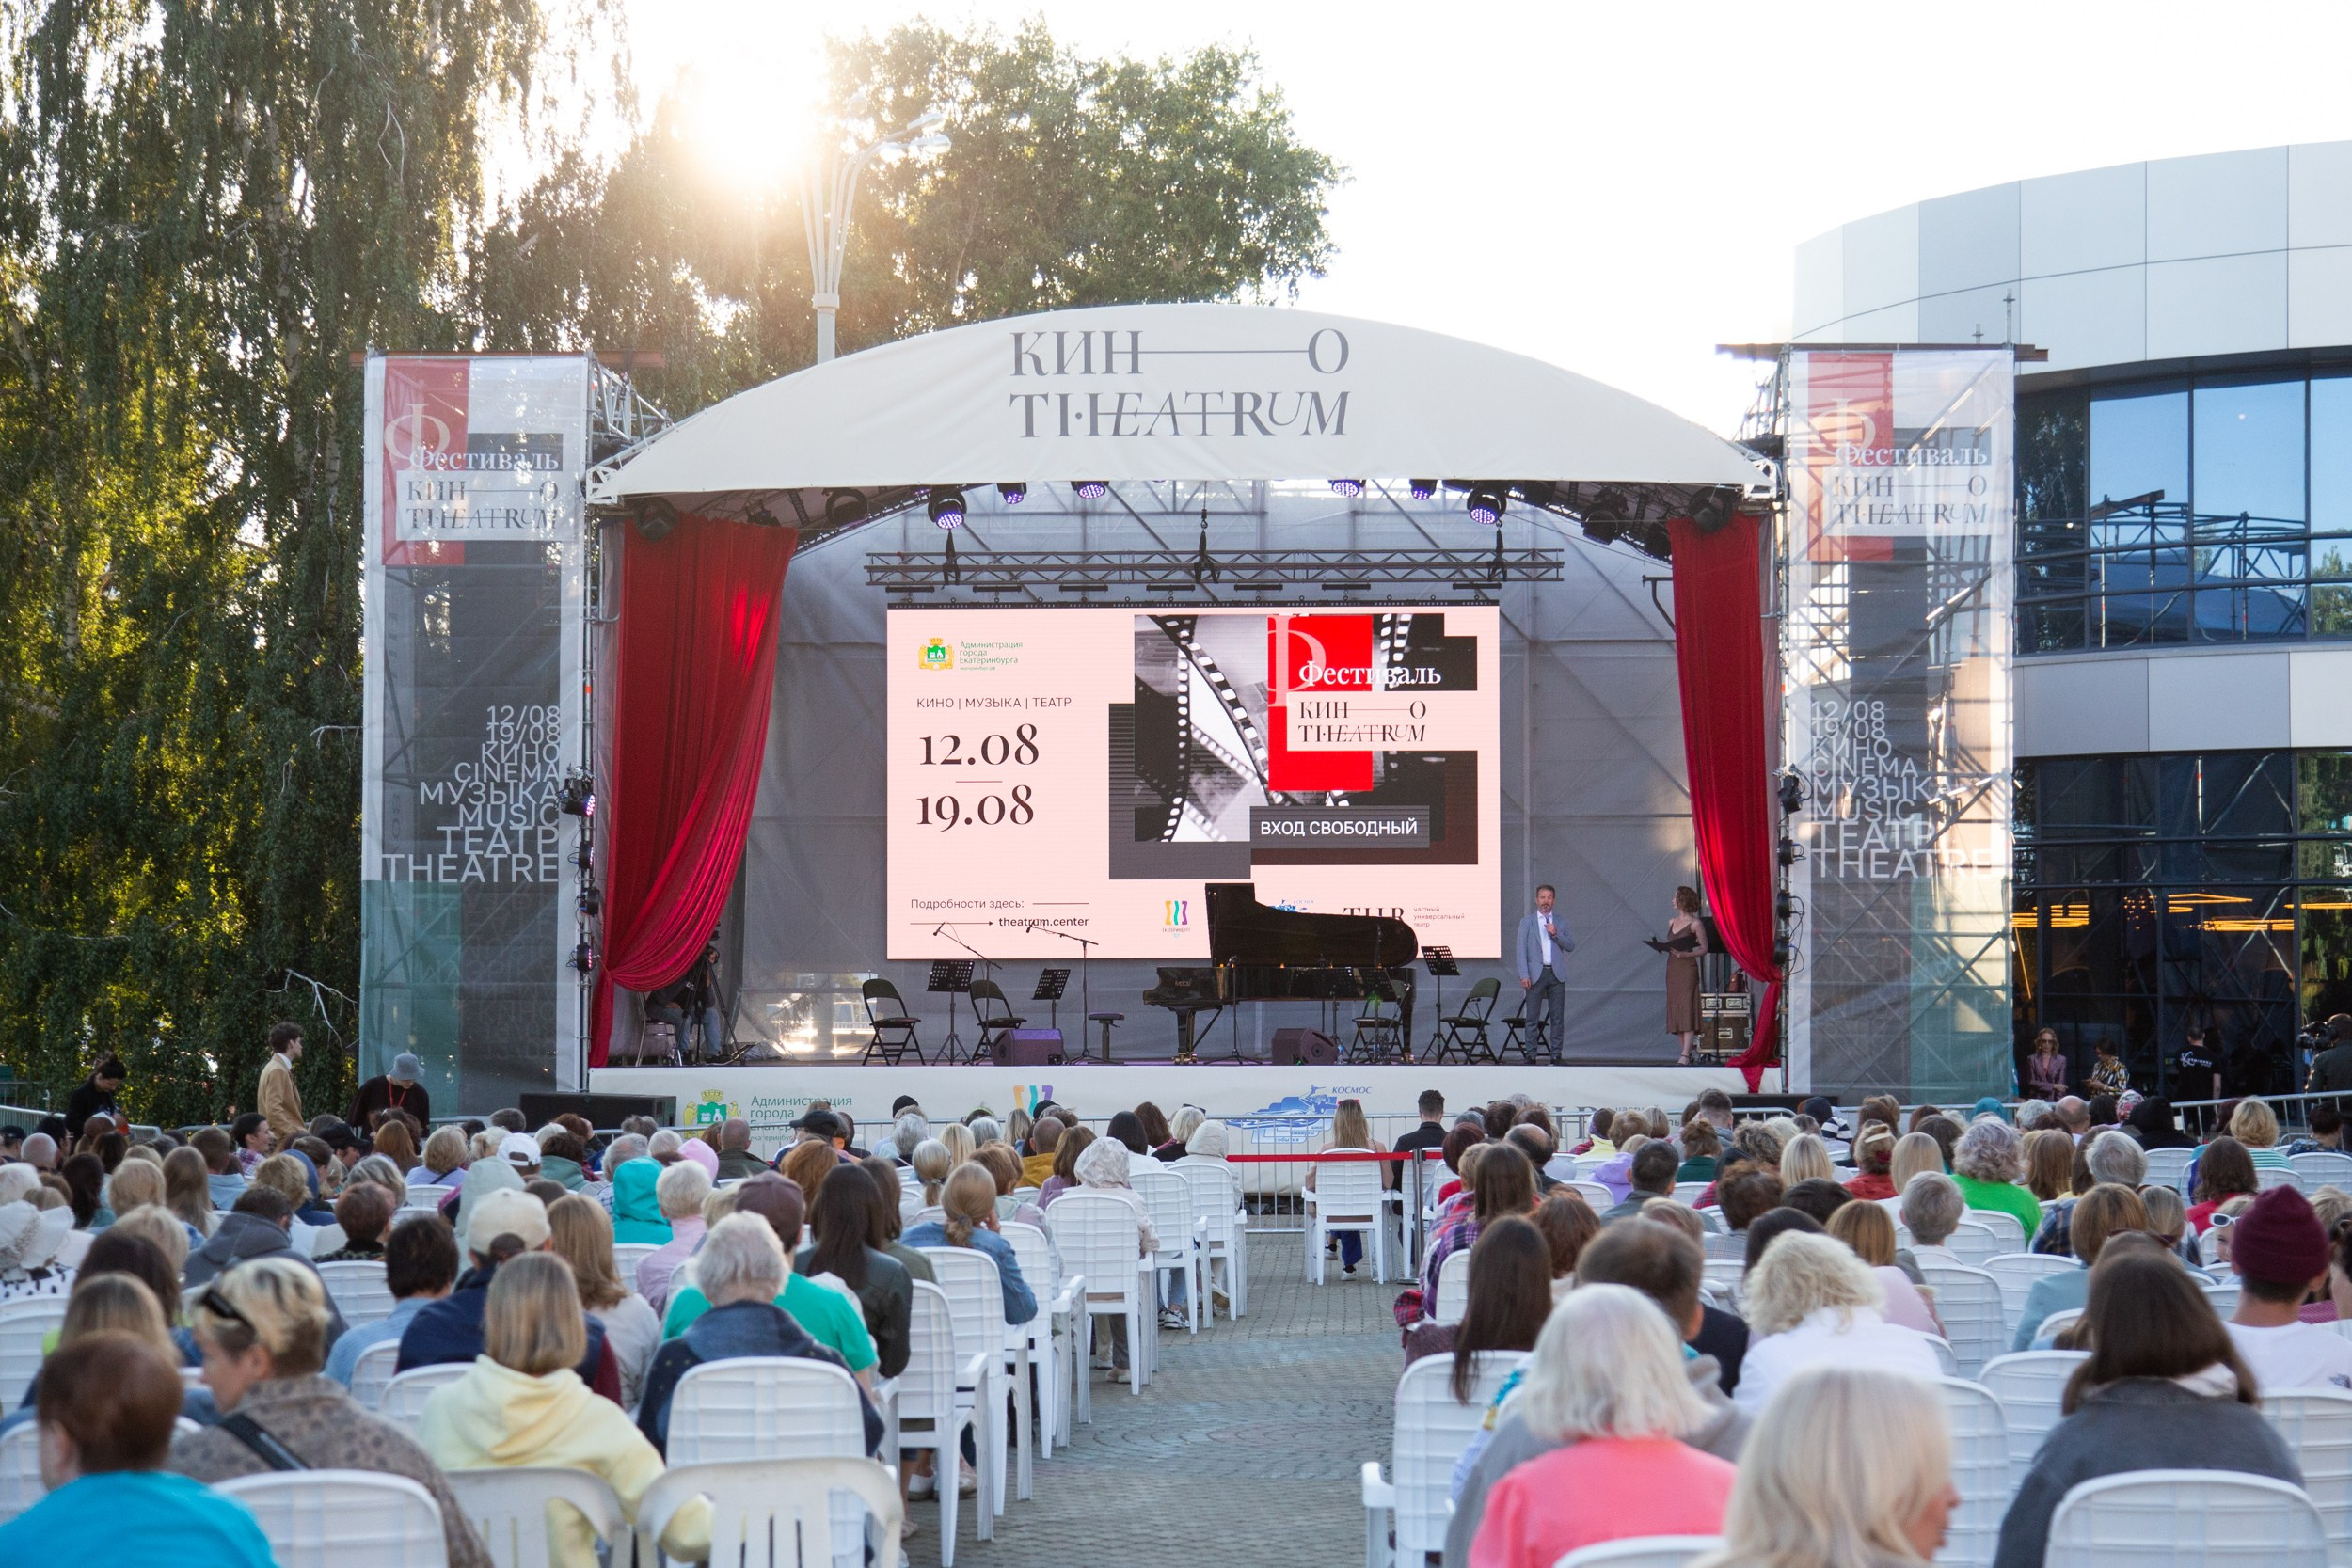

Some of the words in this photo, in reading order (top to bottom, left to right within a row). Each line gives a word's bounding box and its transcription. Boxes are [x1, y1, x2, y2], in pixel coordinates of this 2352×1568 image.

[409, 447, 559, 472] Фестиваль
[1836, 441, 1987, 467] Фестиваль
[960, 657, 1019, 665] Екатеринбурга
[1298, 660, 1441, 687] Фестиваль
[916, 698, 954, 708] КИНО
[965, 698, 1022, 707] МУЗЫКА
[1032, 697, 1072, 707] ТЕАТР
[1811, 700, 1885, 725] 12/08
[486, 705, 561, 731] 12/08
[486, 724, 561, 749] 19/08
[919, 723, 1040, 765] 12.08
[1811, 720, 1886, 744] 19/08
[482, 743, 560, 764] КИНО
[1812, 738, 1893, 759] КИНО
[454, 762, 560, 783] CINEMA
[1811, 757, 1919, 778] CINEMA
[420, 782, 559, 805] МУЗЫКА
[1813, 776, 1955, 800] МУЗЫКА
[459, 803, 559, 828] MUSIC
[916, 784, 1034, 832] 19.08
[1813, 799, 1915, 823] MUSIC
[1261, 821, 1306, 837] ВХОД
[1309, 817, 1418, 837] СВОБОДНЫЙ
[1811, 820, 1936, 850] ТЕАТР
[437, 826, 559, 855] ТЕАТР
[381, 854, 559, 883] THEATRE
[1810, 848, 1992, 879] THEATRE
[911, 898, 986, 911] Подробности
[989, 900, 1025, 910] здесь:
[1413, 912, 1465, 921] универсальный
[998, 917, 1089, 927] theatrum.center
[750, 1109, 795, 1118] города
